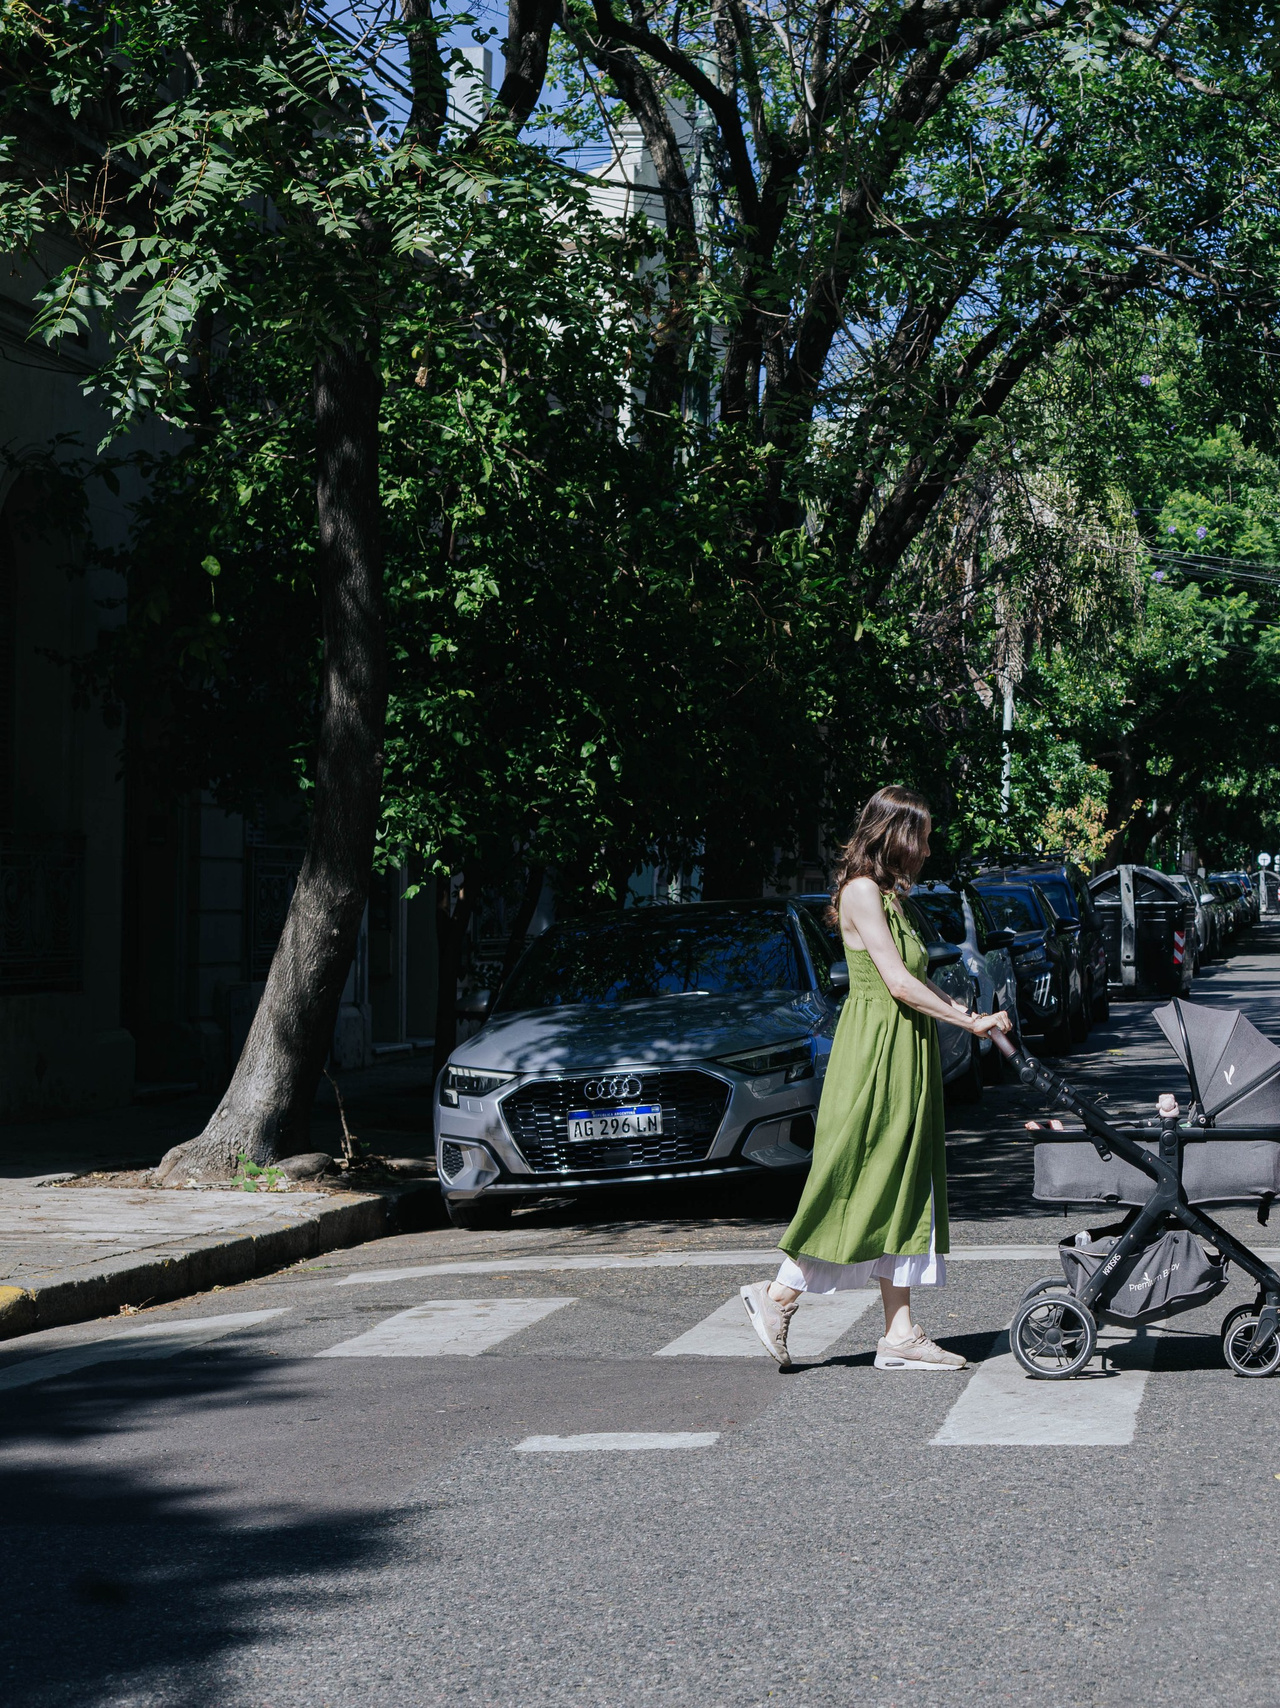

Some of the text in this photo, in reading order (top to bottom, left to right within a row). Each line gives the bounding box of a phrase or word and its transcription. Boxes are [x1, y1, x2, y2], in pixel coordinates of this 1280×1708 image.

[574, 1115, 658, 1138] AG 296 LN
[1162, 1262, 1180, 1278] Bby
